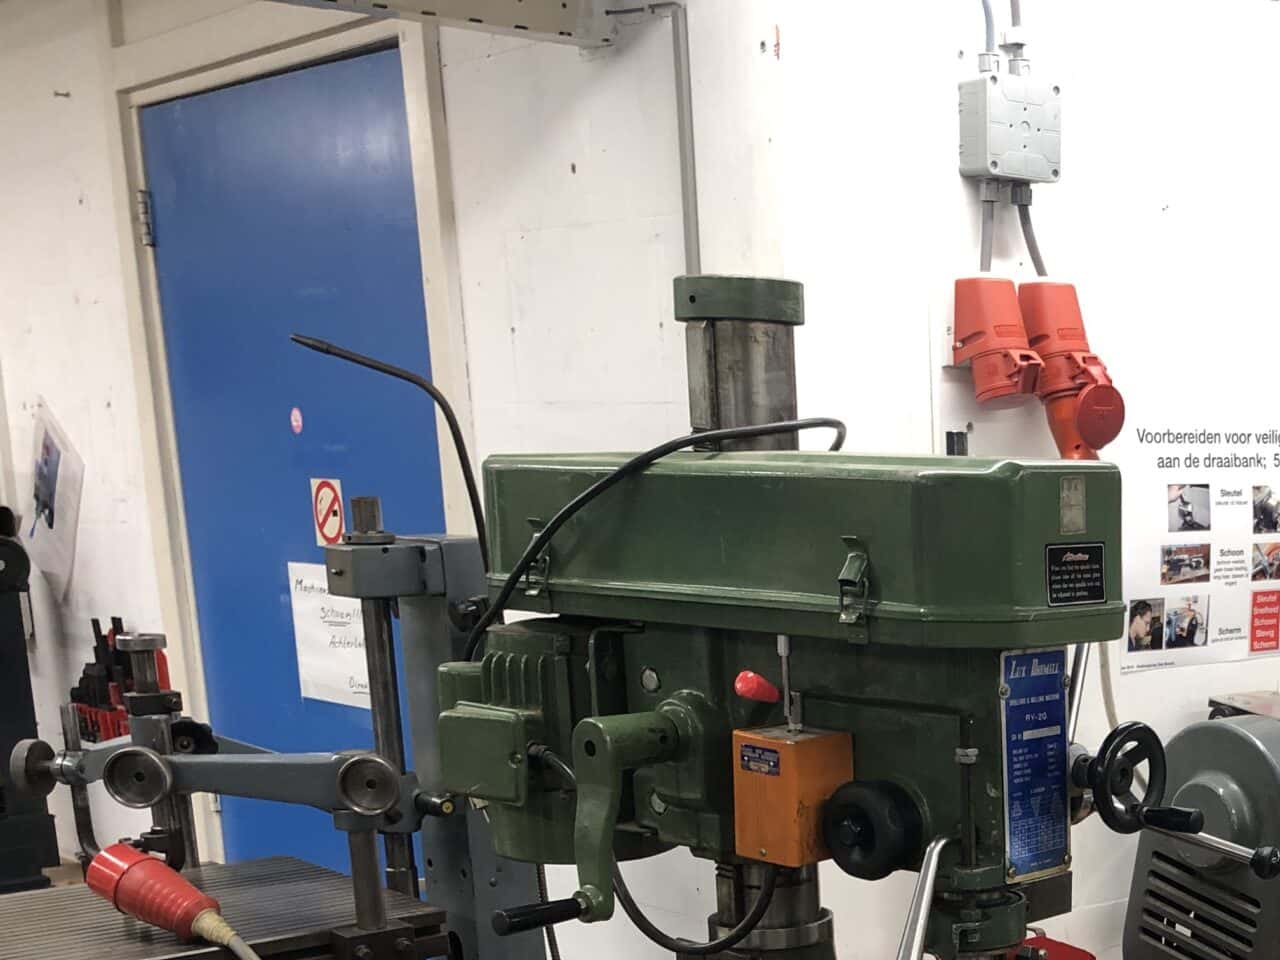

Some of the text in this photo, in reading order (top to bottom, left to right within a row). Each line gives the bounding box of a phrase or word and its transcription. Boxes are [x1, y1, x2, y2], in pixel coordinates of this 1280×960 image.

[1137, 428, 1221, 444] Voorbereiden
[1225, 431, 1251, 444] voor
[1157, 457, 1180, 468] aan
[1184, 453, 1200, 468] de
[1203, 453, 1266, 469] draaibank;
[1220, 489, 1242, 497] Sleutel
[1220, 549, 1244, 557] Schoon
